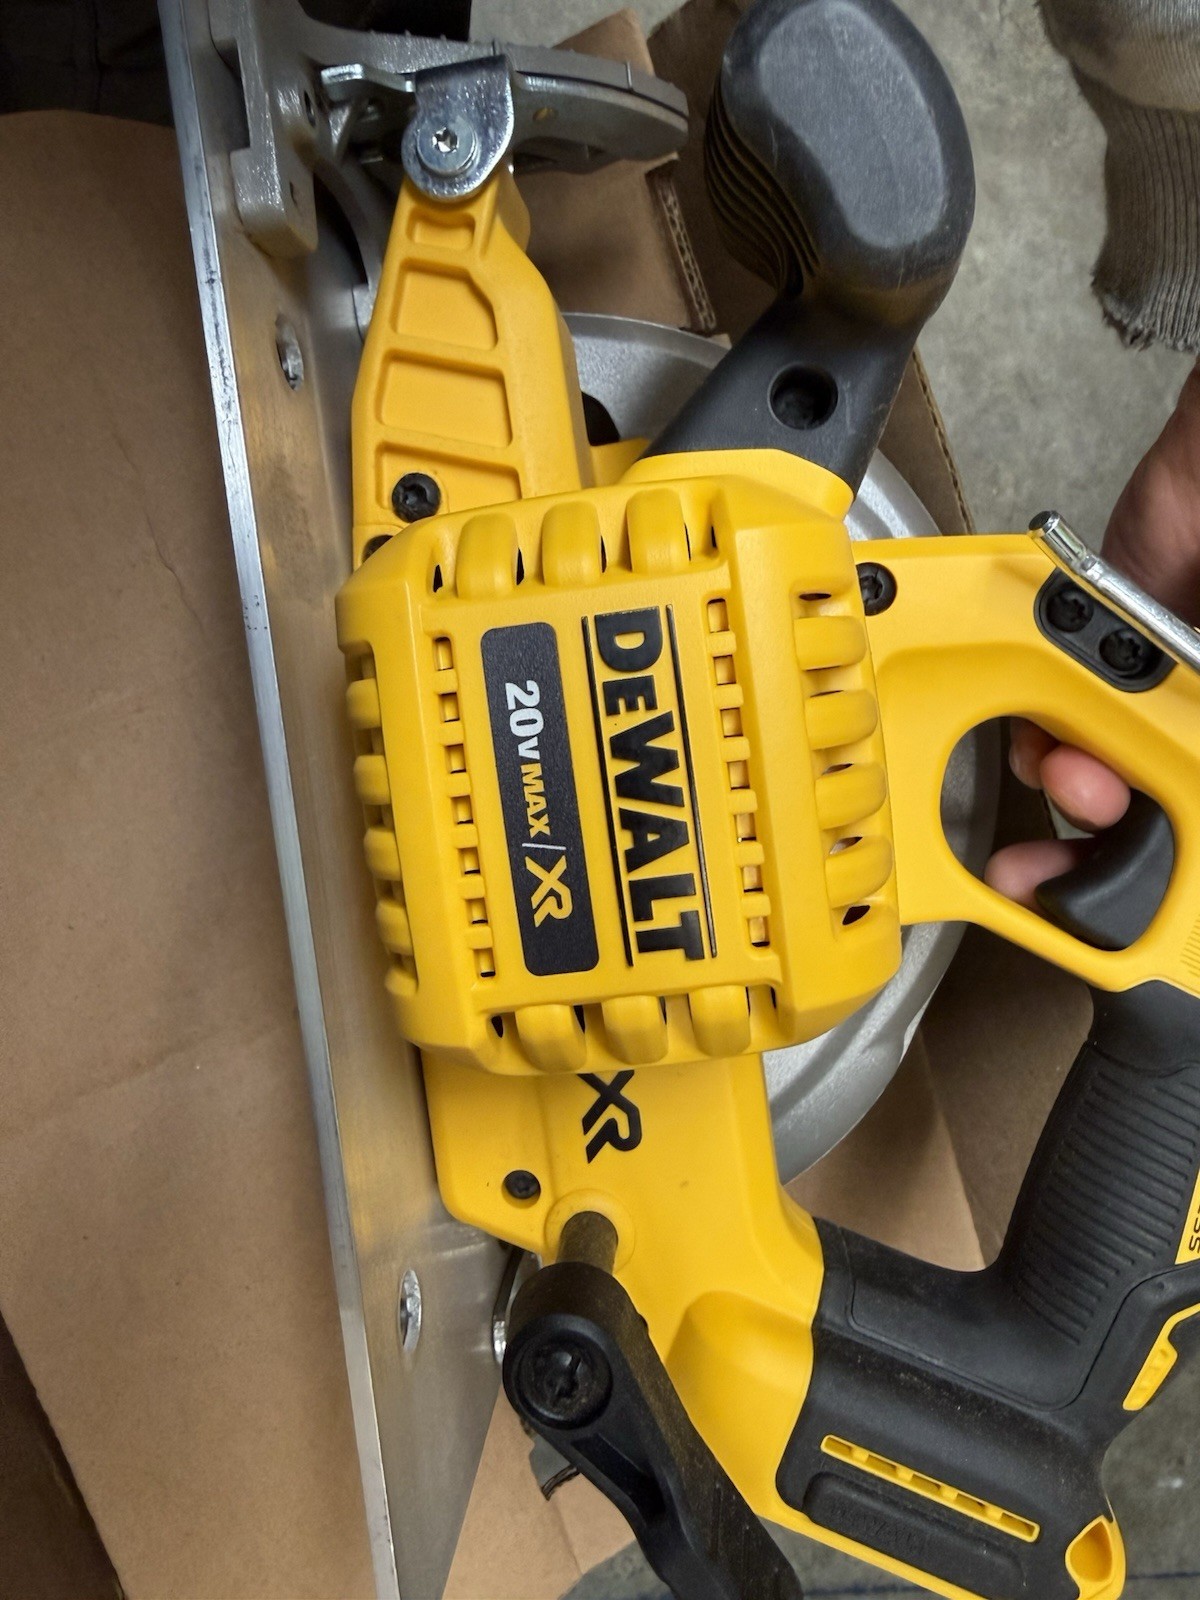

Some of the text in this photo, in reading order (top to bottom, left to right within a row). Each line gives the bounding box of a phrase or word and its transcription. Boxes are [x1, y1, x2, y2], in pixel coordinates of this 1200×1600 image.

[594, 606, 704, 961] DEWALT
[525, 856, 573, 927] XR
[576, 1069, 642, 1164] XR
